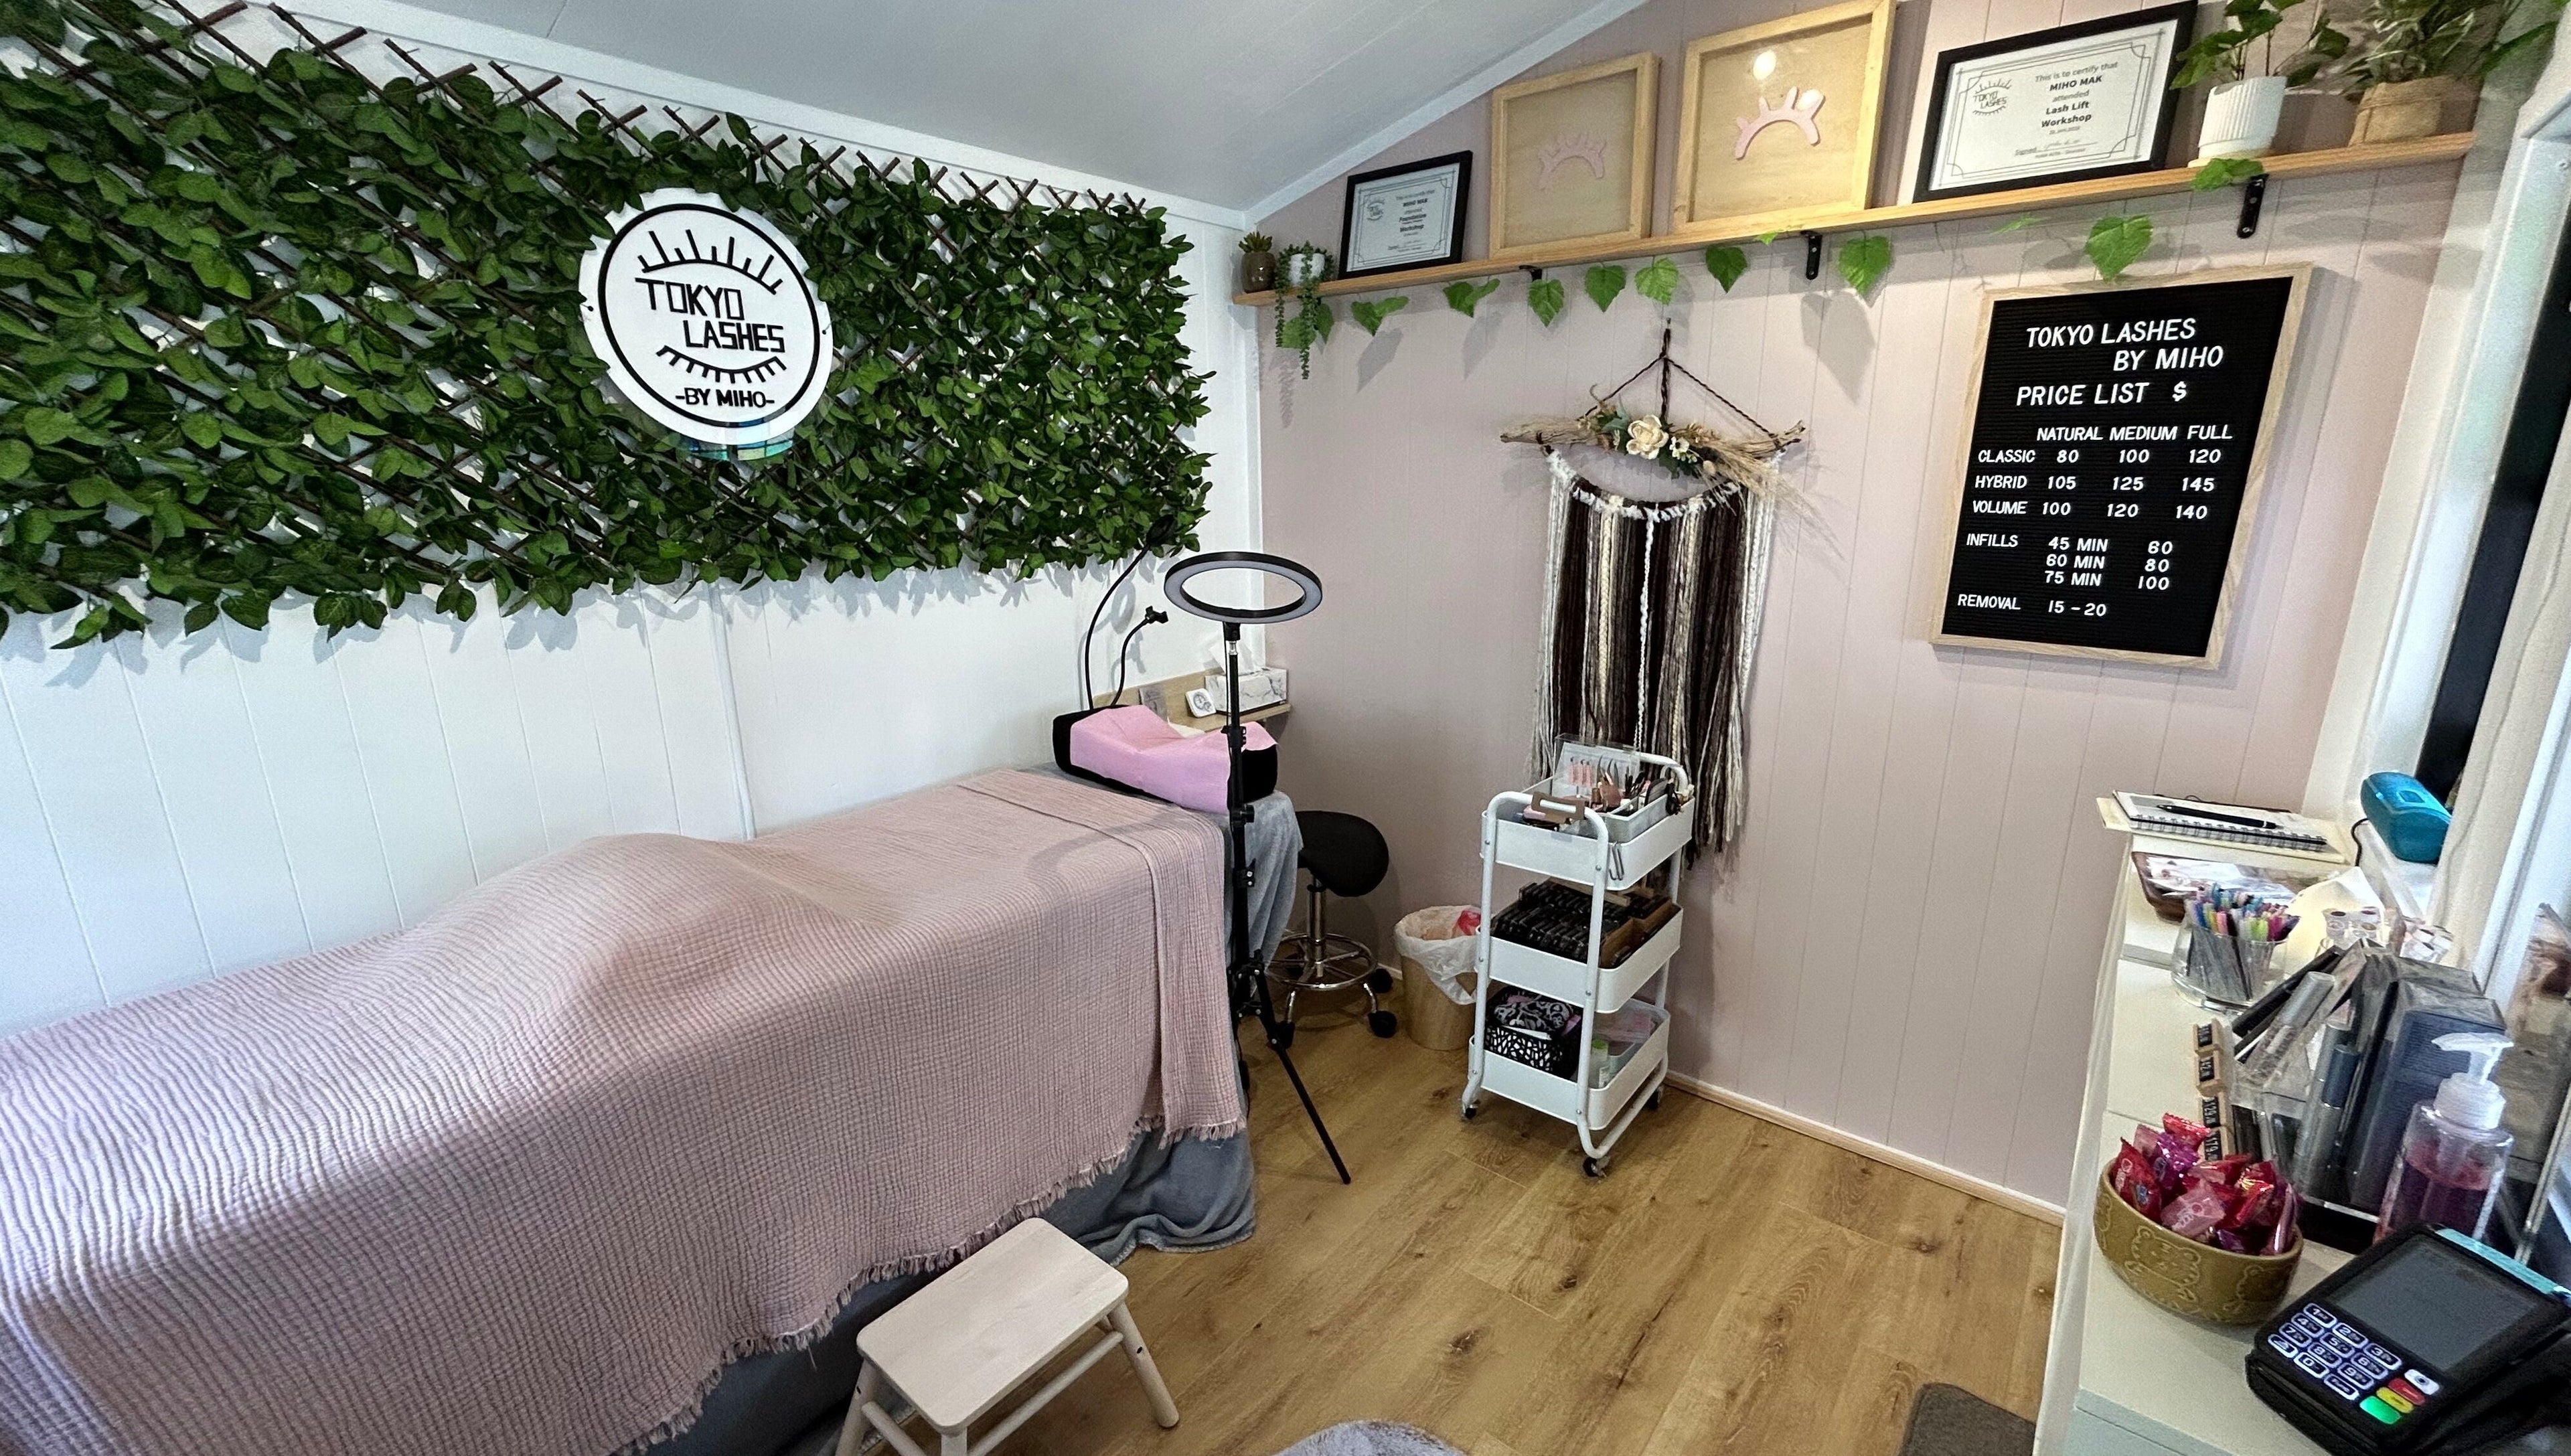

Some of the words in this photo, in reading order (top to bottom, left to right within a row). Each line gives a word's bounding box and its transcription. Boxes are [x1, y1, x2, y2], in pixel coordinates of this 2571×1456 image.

[2072, 64, 2098, 76] certify
[2101, 62, 2118, 70] that
[2049, 80, 2077, 92] MIHO
[2080, 75, 2102, 86] MAK
[1973, 91, 1999, 102] TOKYO
[1980, 96, 2008, 109] LASHES
[2052, 90, 2090, 102] attended
[2045, 104, 2069, 115] Lash
[2072, 100, 2090, 110] Lift
[2041, 114, 2092, 128] Workshop
[635, 277, 745, 321] TOKYO
[683, 319, 785, 353] LASHES
[2026, 324, 2094, 348] TOKYO
[2100, 317, 2196, 344] LASHES
[2113, 349, 2147, 372] BY
[2155, 345, 2224, 370] MIHO
[2016, 384, 2087, 406] PRICE
[2094, 382, 2150, 404] LIST
[2172, 381, 2187, 402] $
[2036, 426, 2104, 442] NATURAL
[2109, 425, 2178, 441] MEDIUM
[2187, 424, 2233, 440] FULL
[1978, 449, 2036, 463] CLASSIC
[2056, 449, 2080, 463] 80
[2119, 449, 2150, 463] 100
[2189, 449, 2222, 464] 120
[1974, 475, 2028, 489] HYBRID
[2047, 475, 2076, 490] 105
[2112, 476, 2144, 491] 125
[2182, 477, 2215, 492] 145
[1972, 499, 2029, 515] VOLUME
[2042, 501, 2072, 515] 100
[2107, 503, 2139, 517] 120
[2176, 505, 2208, 519] 140
[1966, 533, 2019, 548] INFILLS
[2048, 536, 2070, 551] 45
[2076, 538, 2109, 552] MIN
[2147, 540, 2173, 555] 60
[2046, 553, 2068, 568] 60
[2074, 555, 2106, 570] MIN
[2144, 558, 2170, 573] 80
[2044, 570, 2064, 584] 75
[2071, 572, 2102, 586] MIN
[2138, 576, 2170, 590] 100
[1957, 594, 2021, 611] REMOVAL
[2339, 1327, 2351, 1336] 2
[2329, 1338, 2339, 1346] 5
[2314, 1346, 2325, 1355] 8
[2371, 1347, 2383, 1356] 3
[2303, 1357, 2315, 1366] 0
[2357, 1357, 2369, 1366] 6
[2344, 1367, 2356, 1376] 9
